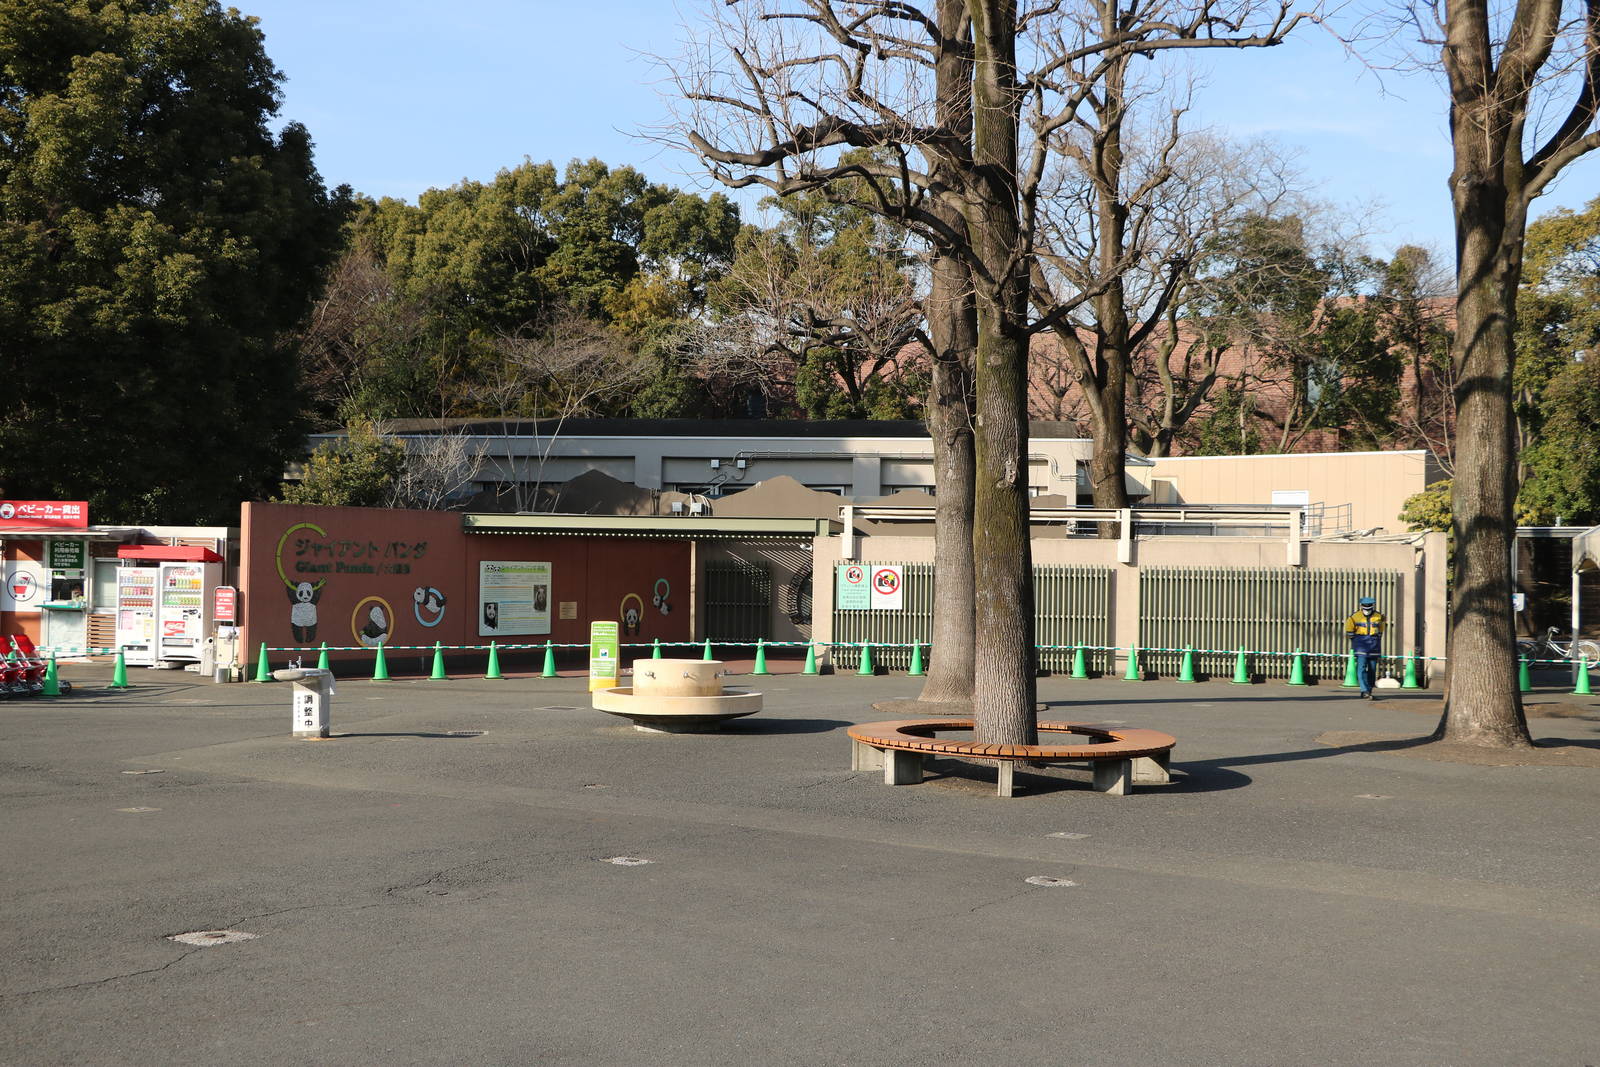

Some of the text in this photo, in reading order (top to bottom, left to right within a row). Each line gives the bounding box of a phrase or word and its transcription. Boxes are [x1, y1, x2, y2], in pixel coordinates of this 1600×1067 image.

[18, 505, 80, 514] ベビーカー貸出
[295, 561, 331, 573] Giant
[336, 561, 374, 573] Panda
